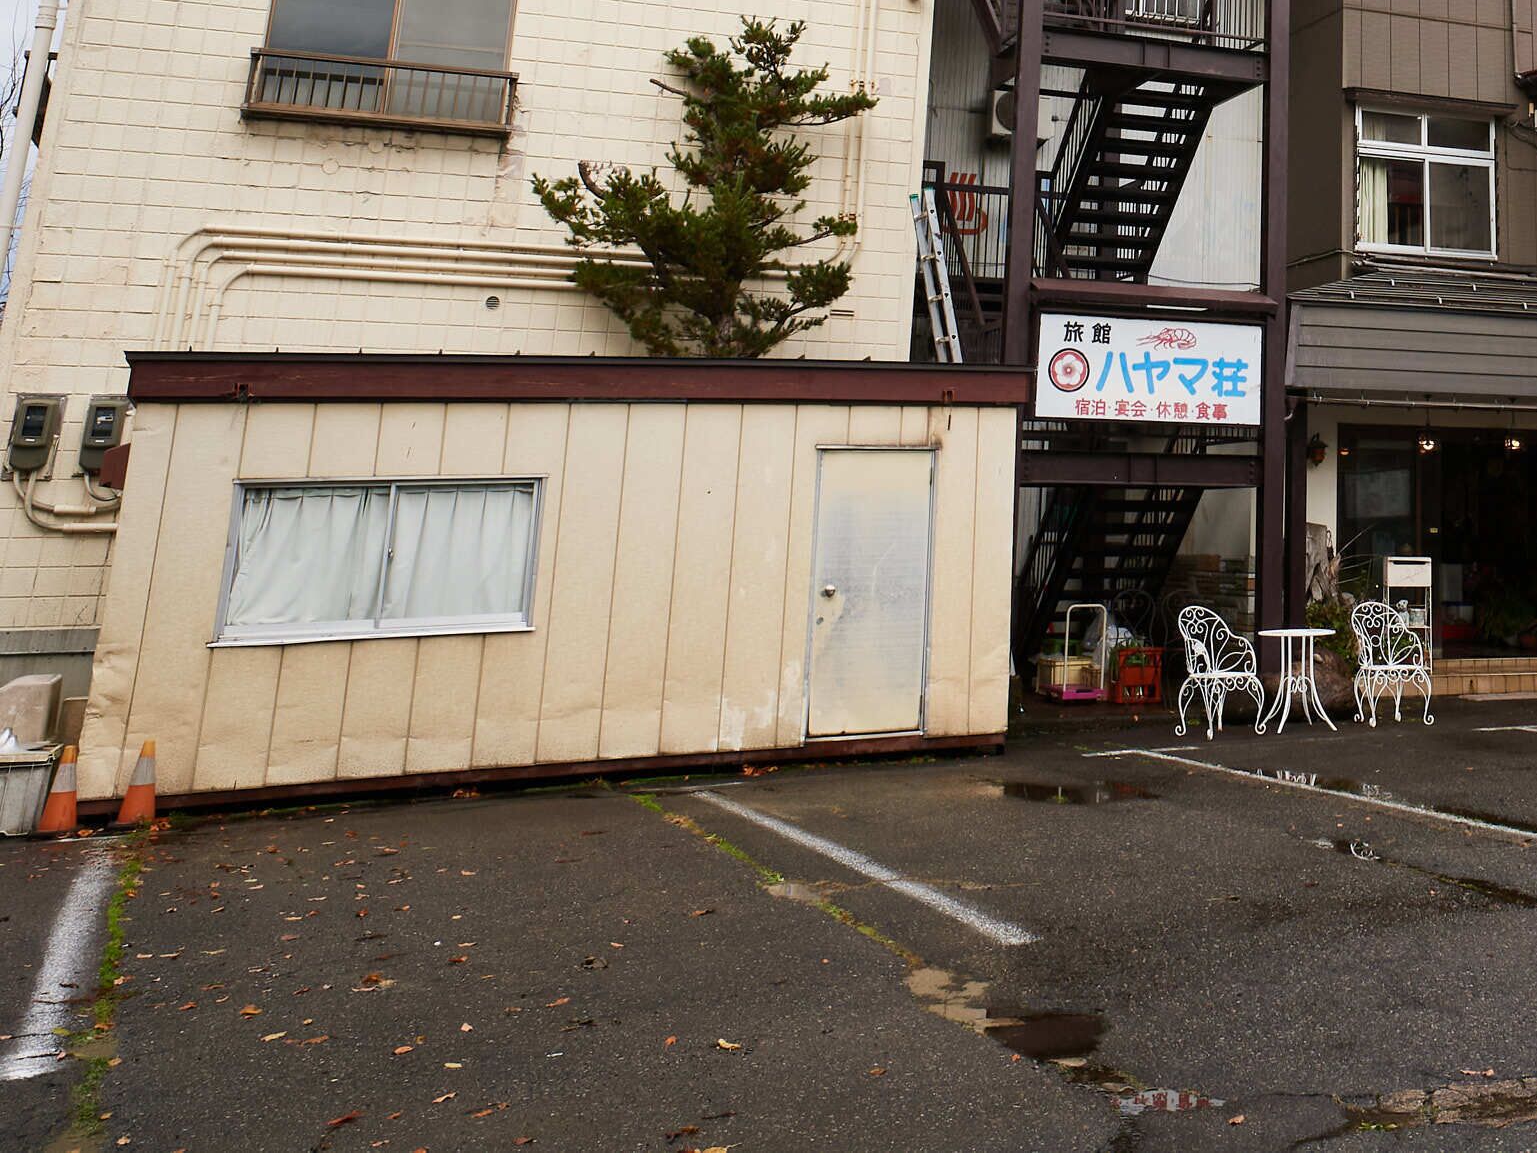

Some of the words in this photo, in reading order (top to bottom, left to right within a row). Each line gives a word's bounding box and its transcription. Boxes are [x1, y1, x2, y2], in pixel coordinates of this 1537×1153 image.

[1063, 321, 1112, 345] 旅館
[1095, 350, 1249, 398] ハヤマ荘
